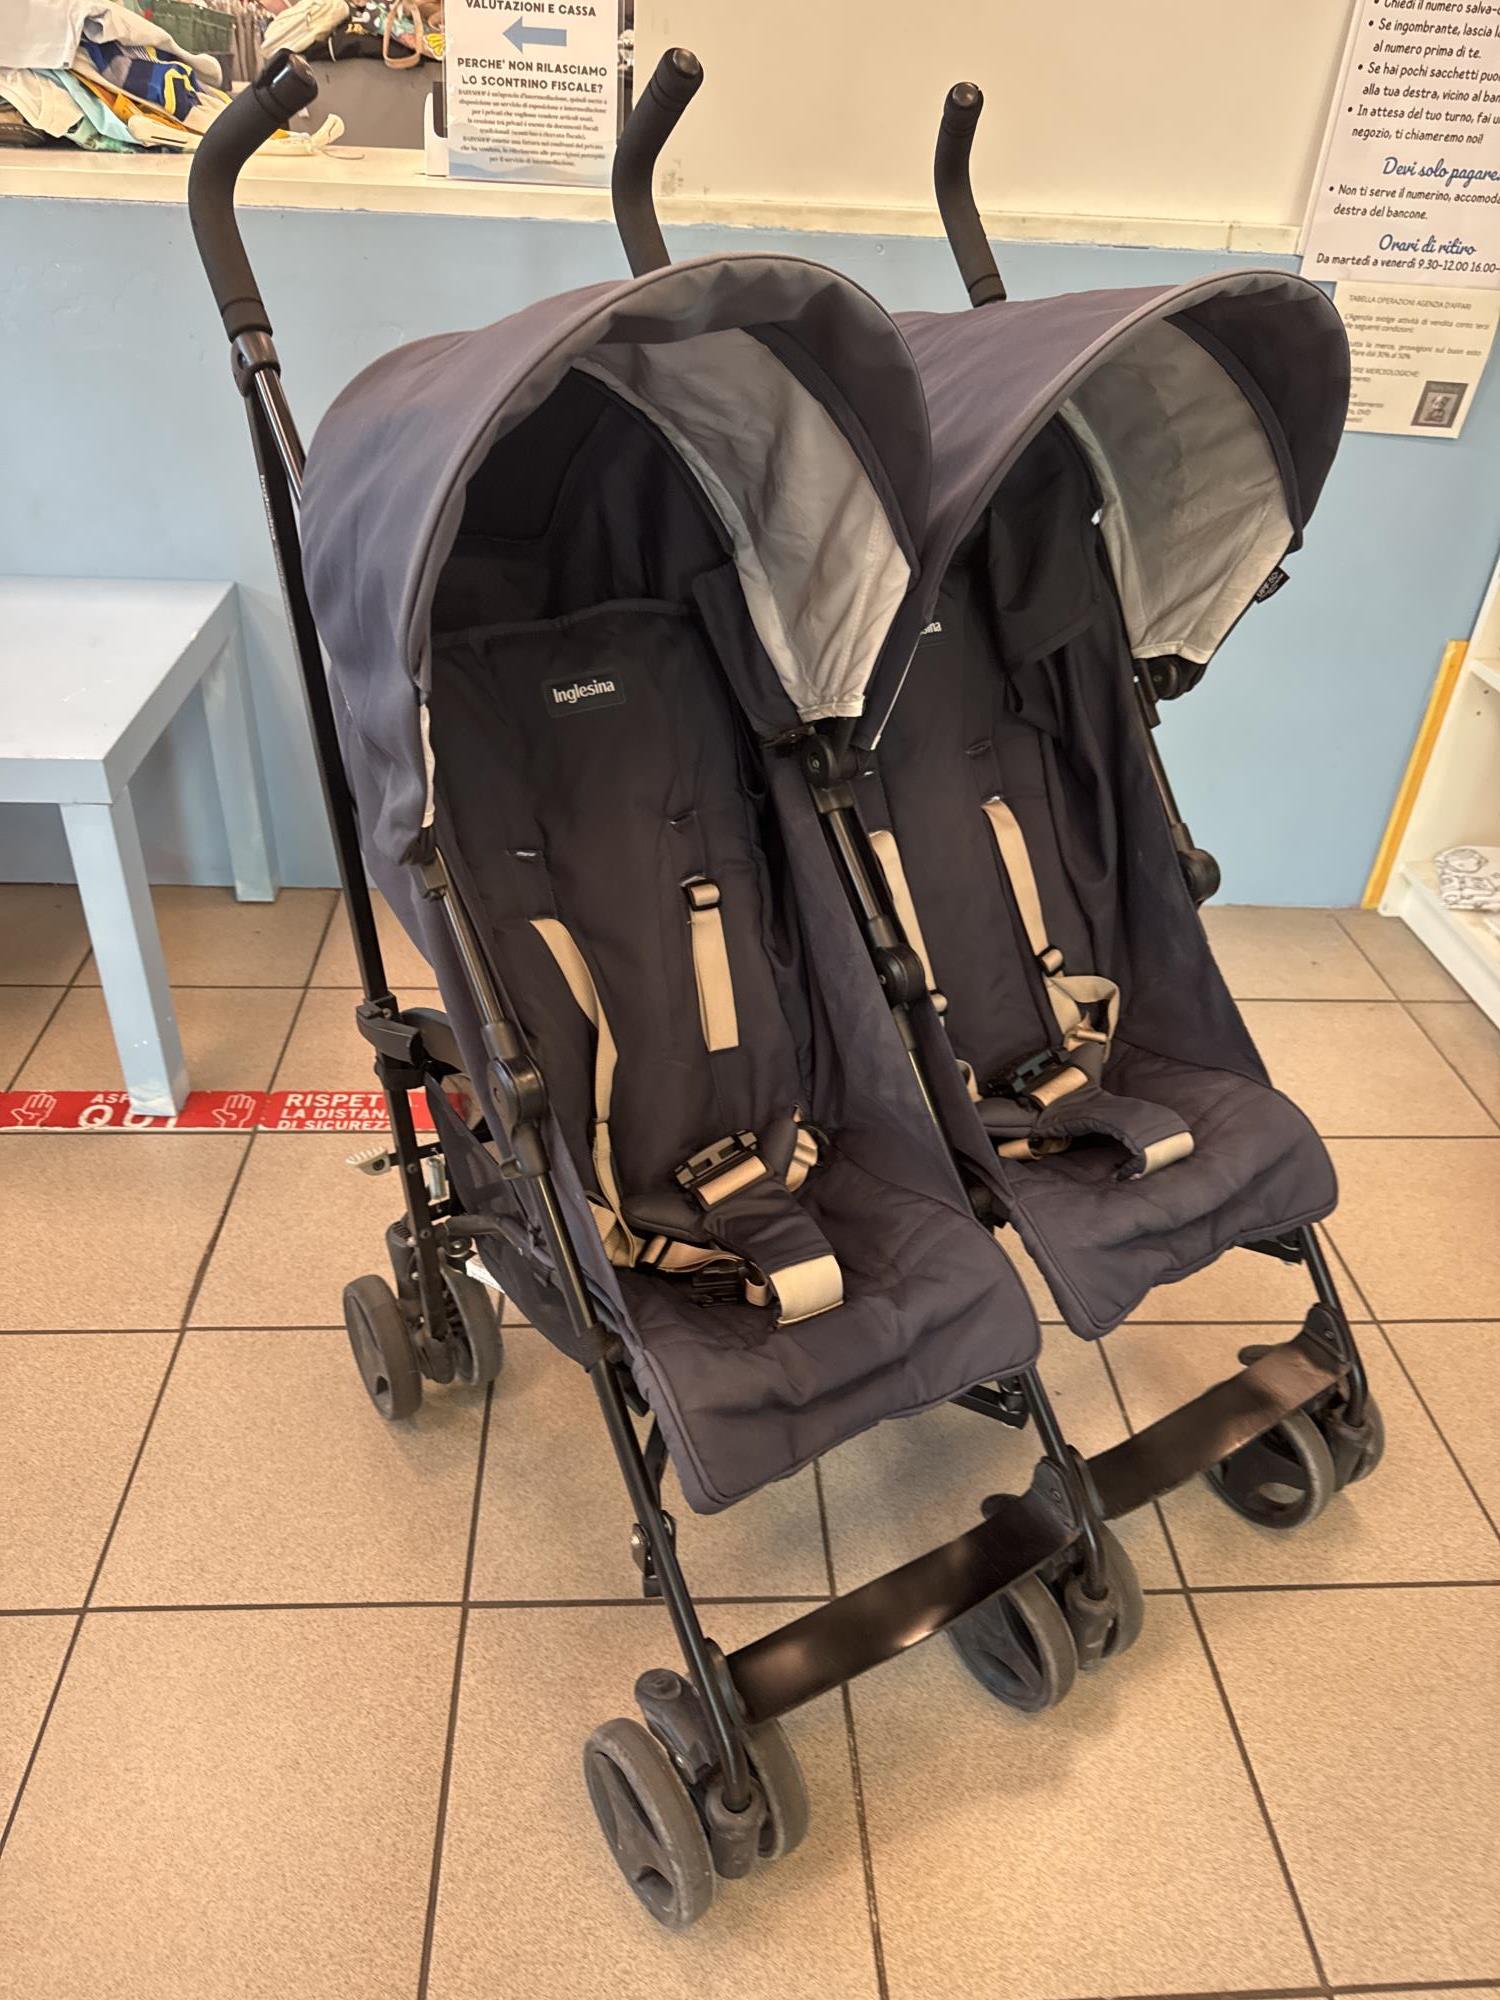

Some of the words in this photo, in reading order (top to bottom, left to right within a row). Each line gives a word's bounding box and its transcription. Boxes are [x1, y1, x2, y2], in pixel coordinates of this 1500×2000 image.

[466, 0, 545, 13] VALUTAZIONI
[548, 4, 555, 13] E
[559, 5, 596, 16] CASSA
[1426, 1, 1463, 13] numero
[1379, 18, 1392, 31] Se
[1394, 20, 1460, 36] ingombrante,
[1463, 23, 1492, 37] lascia
[1373, 40, 1383, 53] al
[1385, 43, 1422, 55] numero
[1423, 45, 1453, 58] prima
[1456, 45, 1465, 57] di
[458, 58, 506, 69] PERCHE'
[509, 61, 533, 71] NON
[536, 63, 607, 77] RILASCIAMO
[1368, 62, 1381, 74] Se
[1383, 63, 1399, 75] hai
[1400, 64, 1428, 79] pochi
[1430, 66, 1478, 81] sacchetti
[462, 75, 477, 85] LO
[482, 76, 547, 90] SCONTRINO
[552, 81, 603, 93] FISCALE?
[1363, 84, 1380, 96] alla
[1384, 86, 1400, 97] tua
[1403, 86, 1439, 100] destra,
[1443, 90, 1469, 101] vicino
[1472, 90, 1482, 102] al
[1357, 104, 1368, 117] In
[1370, 107, 1404, 119] attesa
[1408, 108, 1422, 120] del
[1425, 111, 1442, 121] tuo
[1445, 112, 1474, 124] turno,
[1477, 112, 1491, 124] fai
[1352, 128, 1392, 140] negozio,
[1396, 130, 1403, 139] ti
[1405, 129, 1464, 142] chiameremo
[1383, 157, 1417, 176] Devi
[1418, 159, 1449, 177] solo
[1338, 184, 1357, 196] Non
[1359, 186, 1367, 196] ti
[1370, 188, 1396, 198] serve
[1399, 187, 1405, 198] il
[1406, 189, 1451, 201] numerino,
[1334, 204, 1367, 216] destra
[1370, 205, 1385, 217] del
[1388, 207, 1428, 219] bancone.
[1379, 234, 1420, 252] Orari
[1421, 235, 1435, 253] di
[1438, 238, 1476, 255] ritiro
[1317, 253, 1330, 264] Da
[1418, 259, 1468, 272] 9.30-12.00
[553, 680, 615, 704] Inglesina
[286, 1094, 384, 1107] RISPET
[281, 1109, 306, 1119] LA
[278, 1120, 297, 1130] DI
